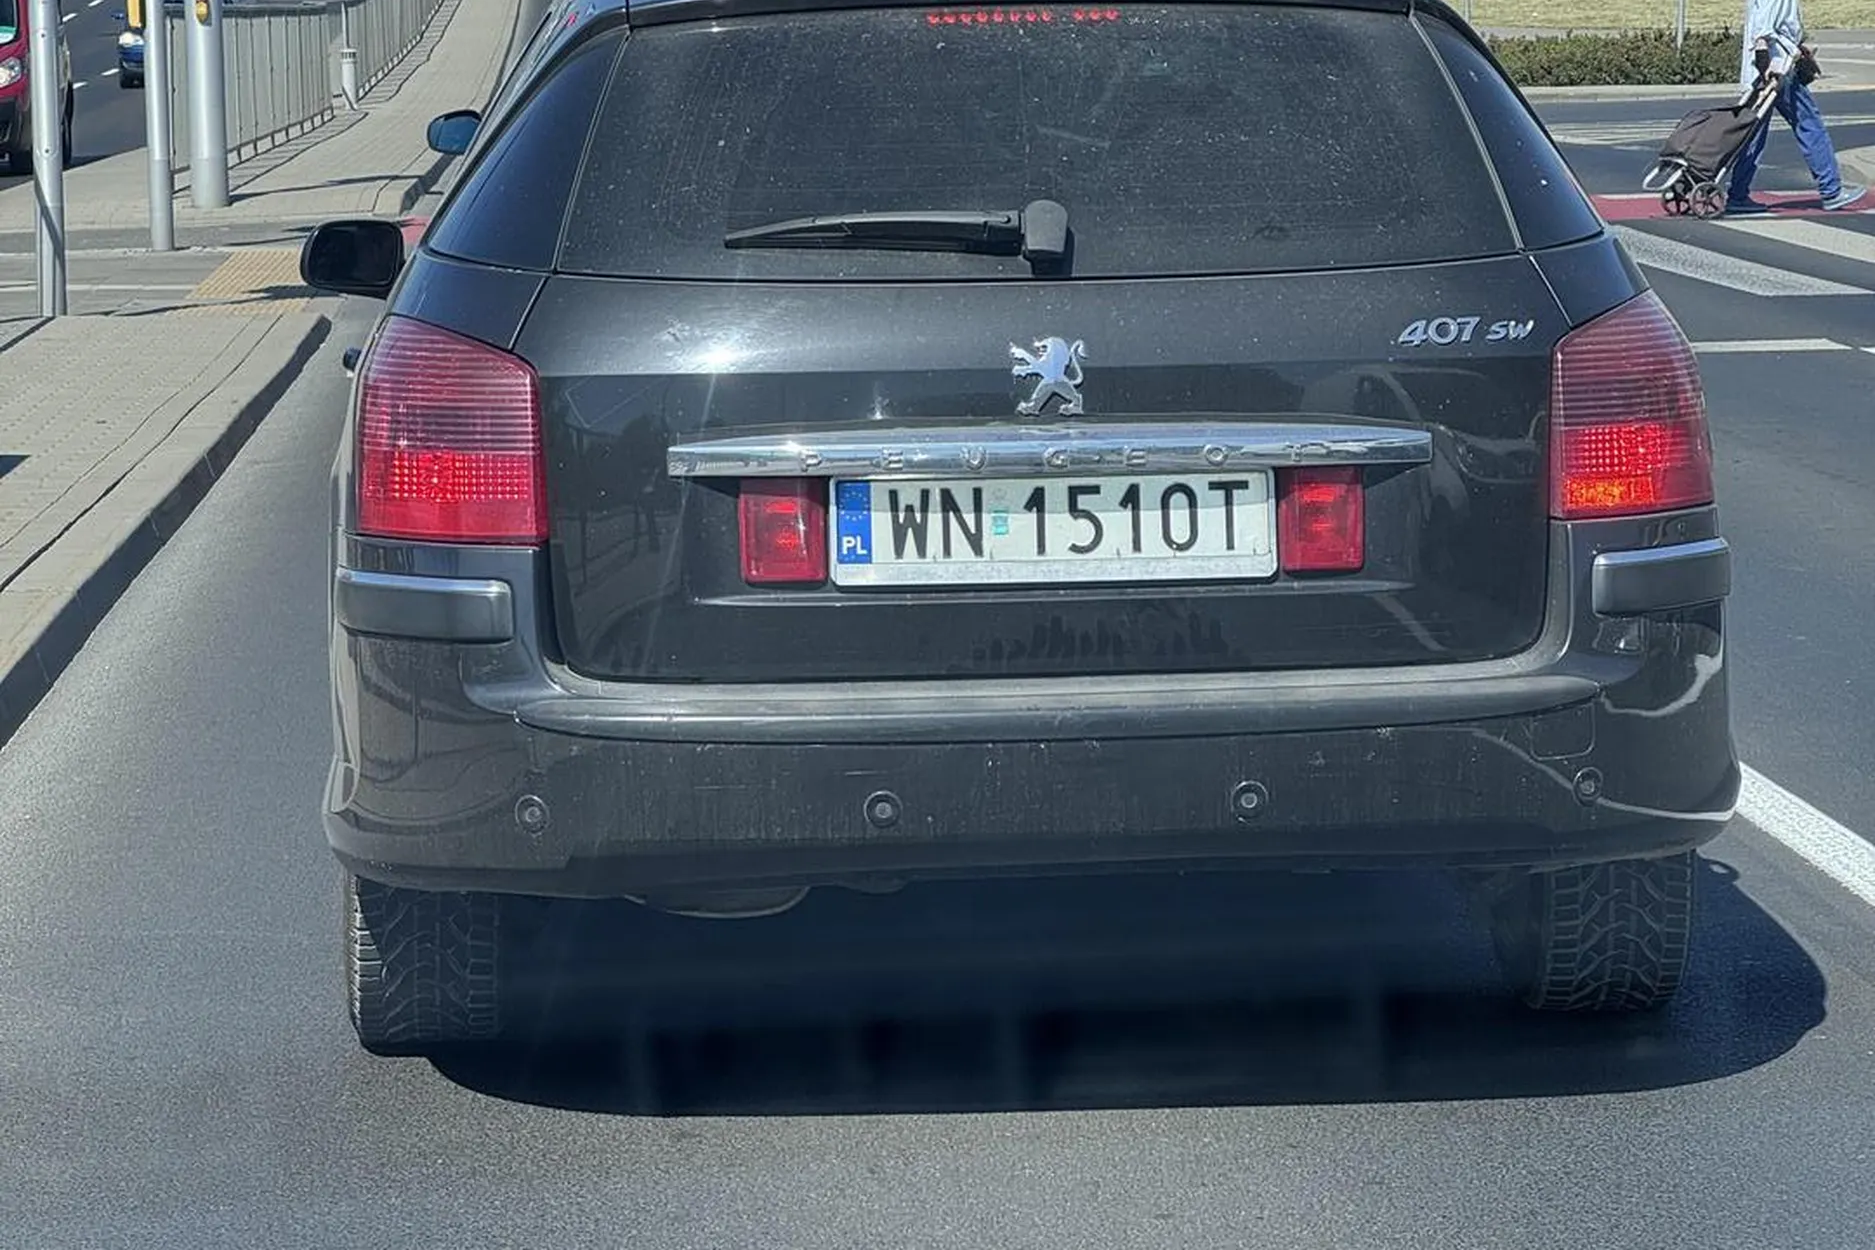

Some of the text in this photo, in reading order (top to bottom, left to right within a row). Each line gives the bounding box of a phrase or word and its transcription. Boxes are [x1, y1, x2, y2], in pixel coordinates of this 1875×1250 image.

[1398, 316, 1535, 346] 407 SW
[801, 441, 1314, 472] PEUGEOT
[888, 480, 1249, 560] WN 1510T
[842, 534, 868, 555] PL
